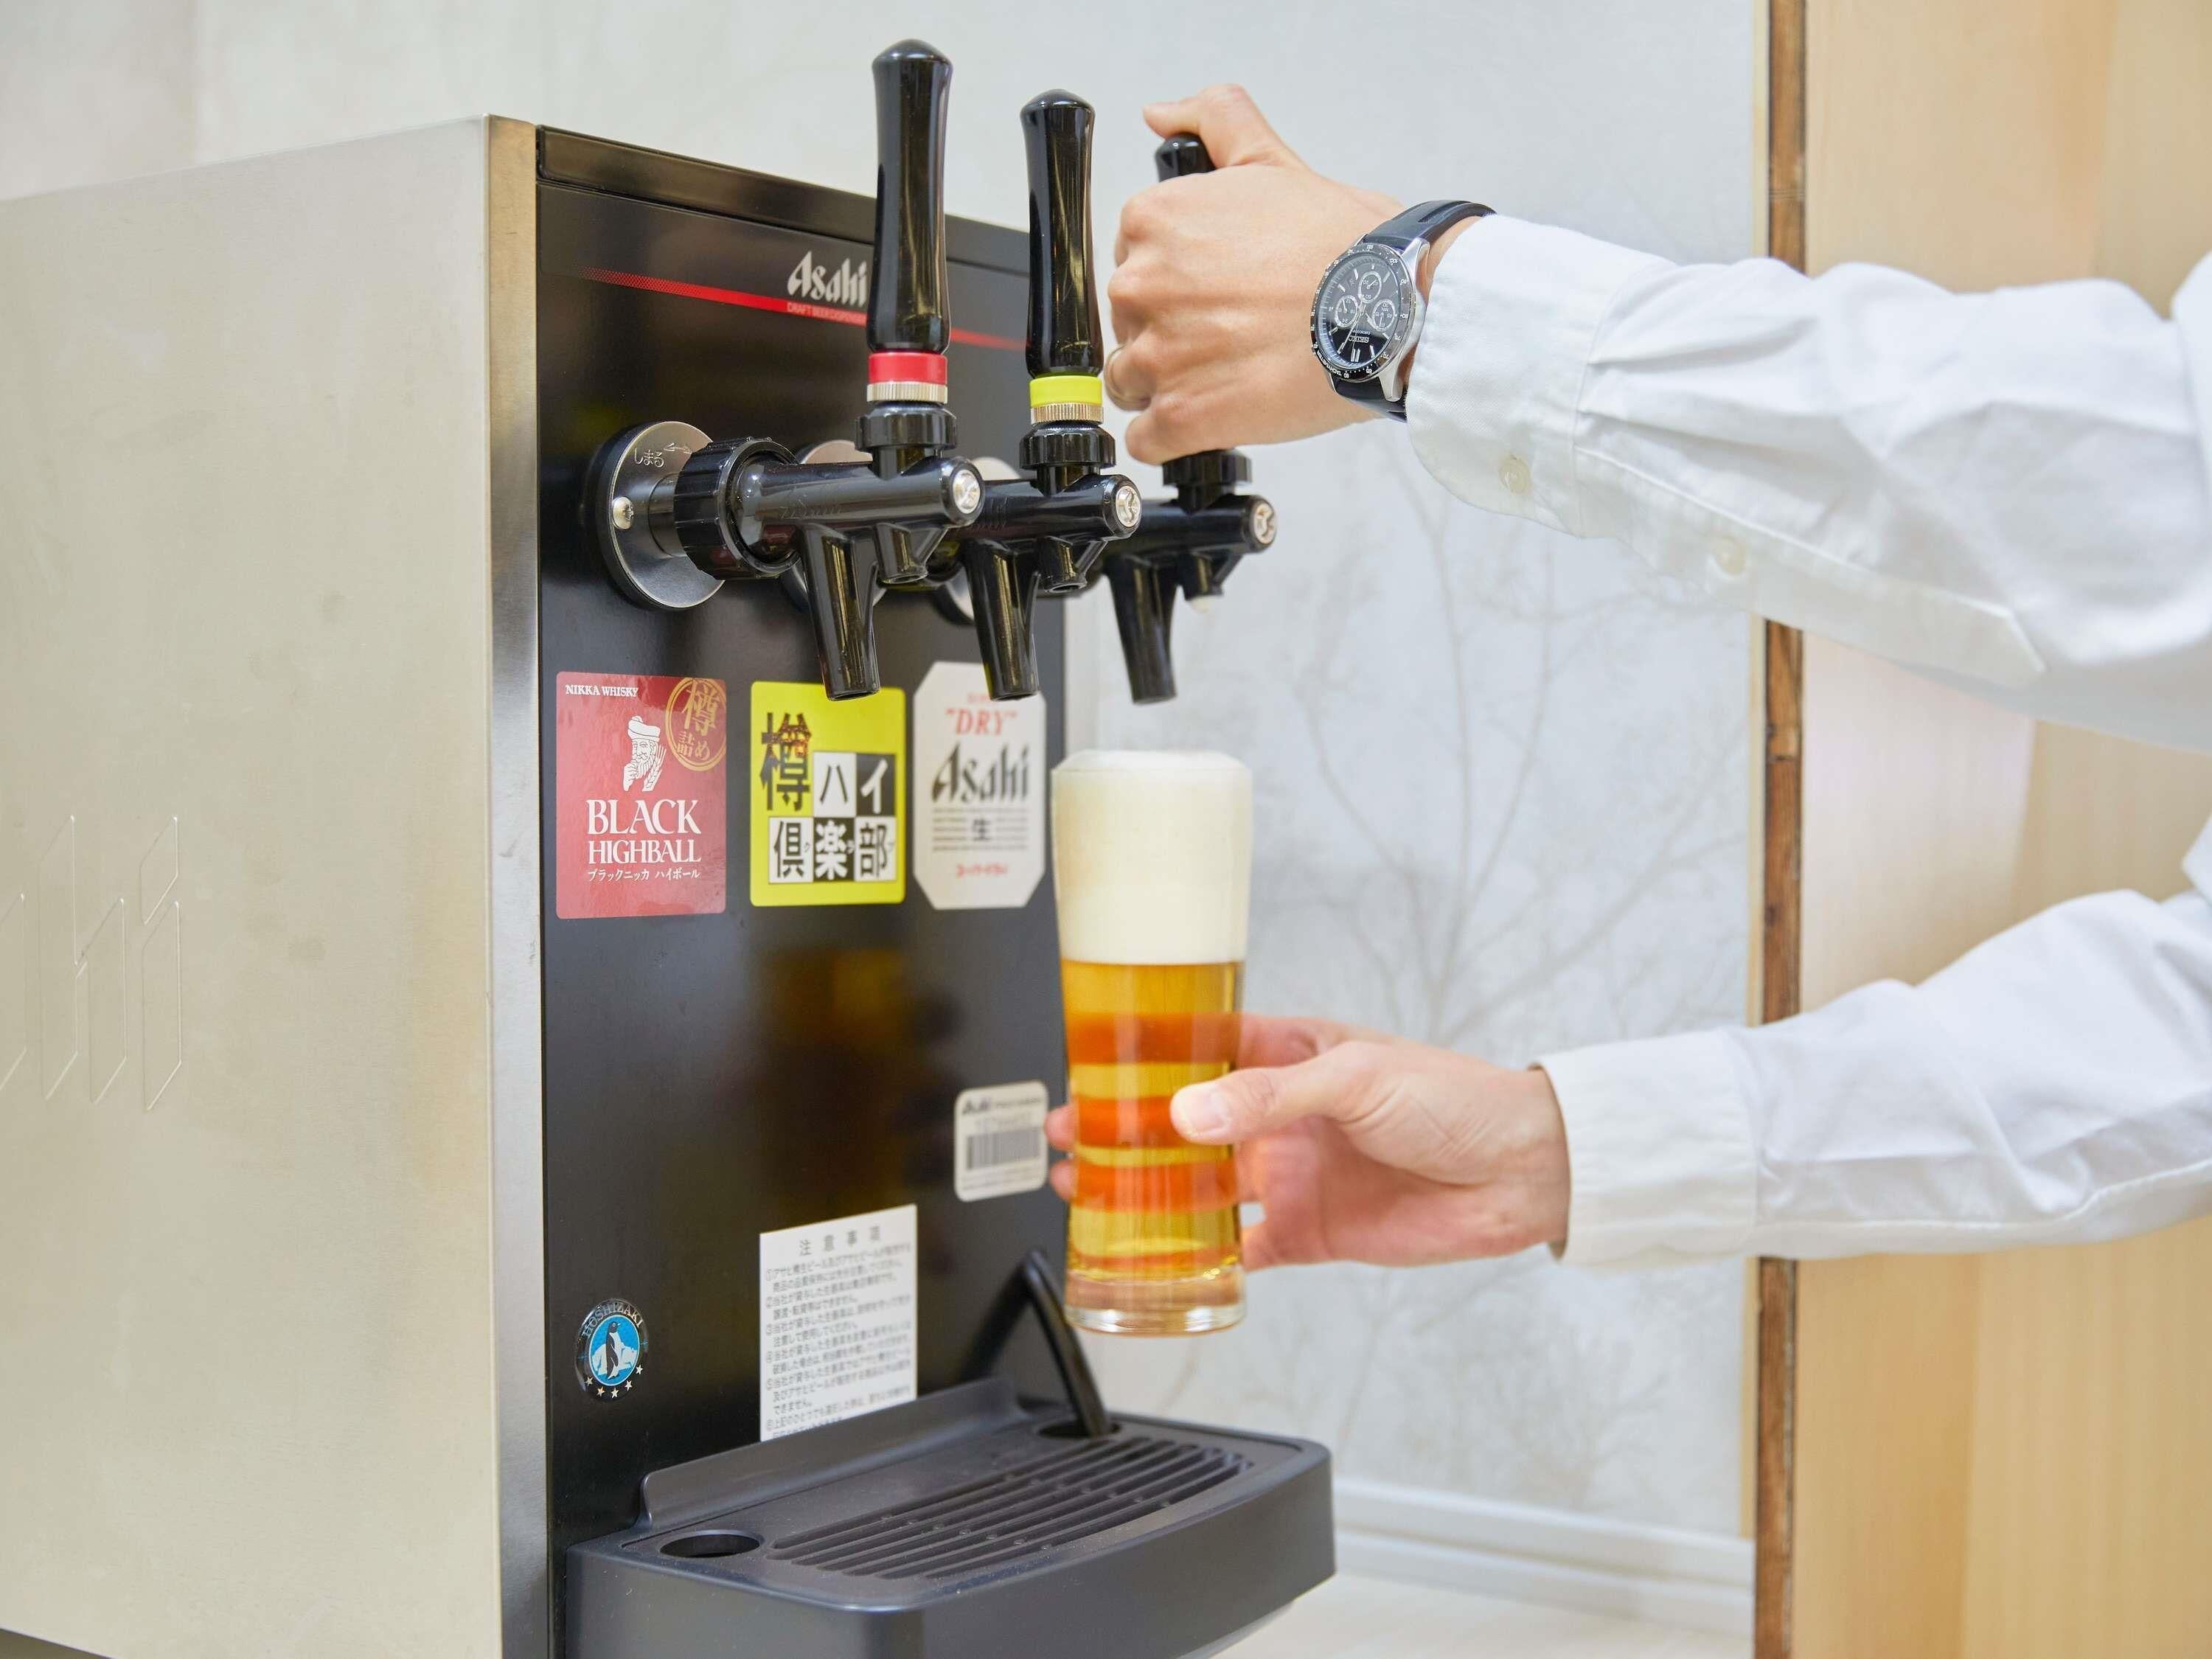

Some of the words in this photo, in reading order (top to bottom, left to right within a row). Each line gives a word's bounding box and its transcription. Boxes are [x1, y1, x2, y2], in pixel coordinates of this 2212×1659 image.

[787, 251, 866, 307] Asahi
[634, 448, 664, 467] しまる
[566, 684, 599, 696] NIKKA
[601, 686, 639, 698] WHISKY
[677, 731, 711, 761] 詰め
[931, 741, 1029, 804] Asahi
[586, 799, 702, 835] BLACK
[972, 818, 991, 841] 生
[588, 839, 702, 865] HIGHBALL
[773, 820, 888, 880] 倶楽部
[588, 868, 650, 882] ブラックニッカ
[655, 867, 700, 880] ハイボール
[799, 1224, 880, 1257] 注意事項
[581, 1301, 644, 1338] HOSHIZAKI
